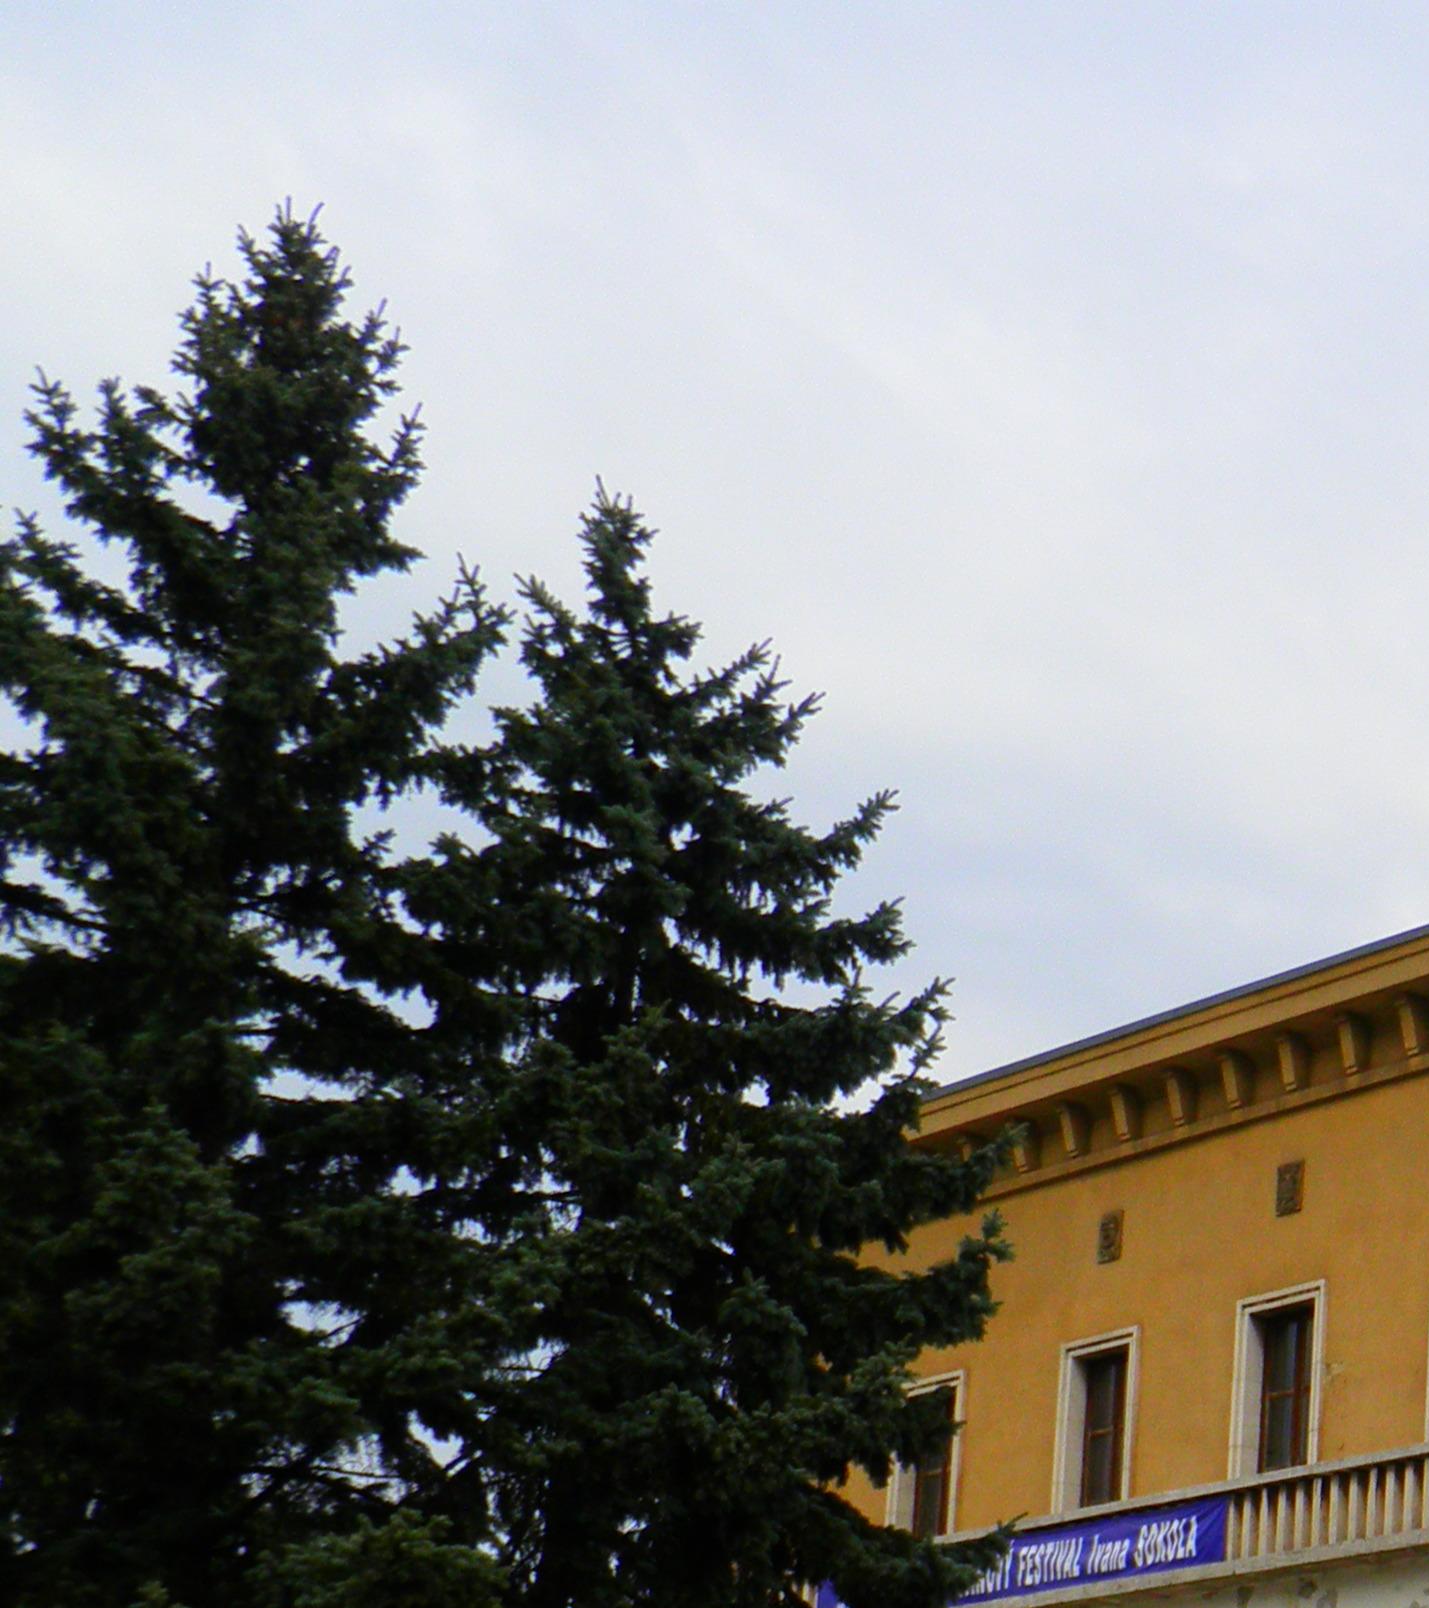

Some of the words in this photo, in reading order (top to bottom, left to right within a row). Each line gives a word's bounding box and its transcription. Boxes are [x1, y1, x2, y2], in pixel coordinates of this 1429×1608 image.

[1017, 1537, 1083, 1587] FESTIVAL
[1086, 1534, 1130, 1575] Ivana
[1133, 1515, 1197, 1567] SOKOLA
